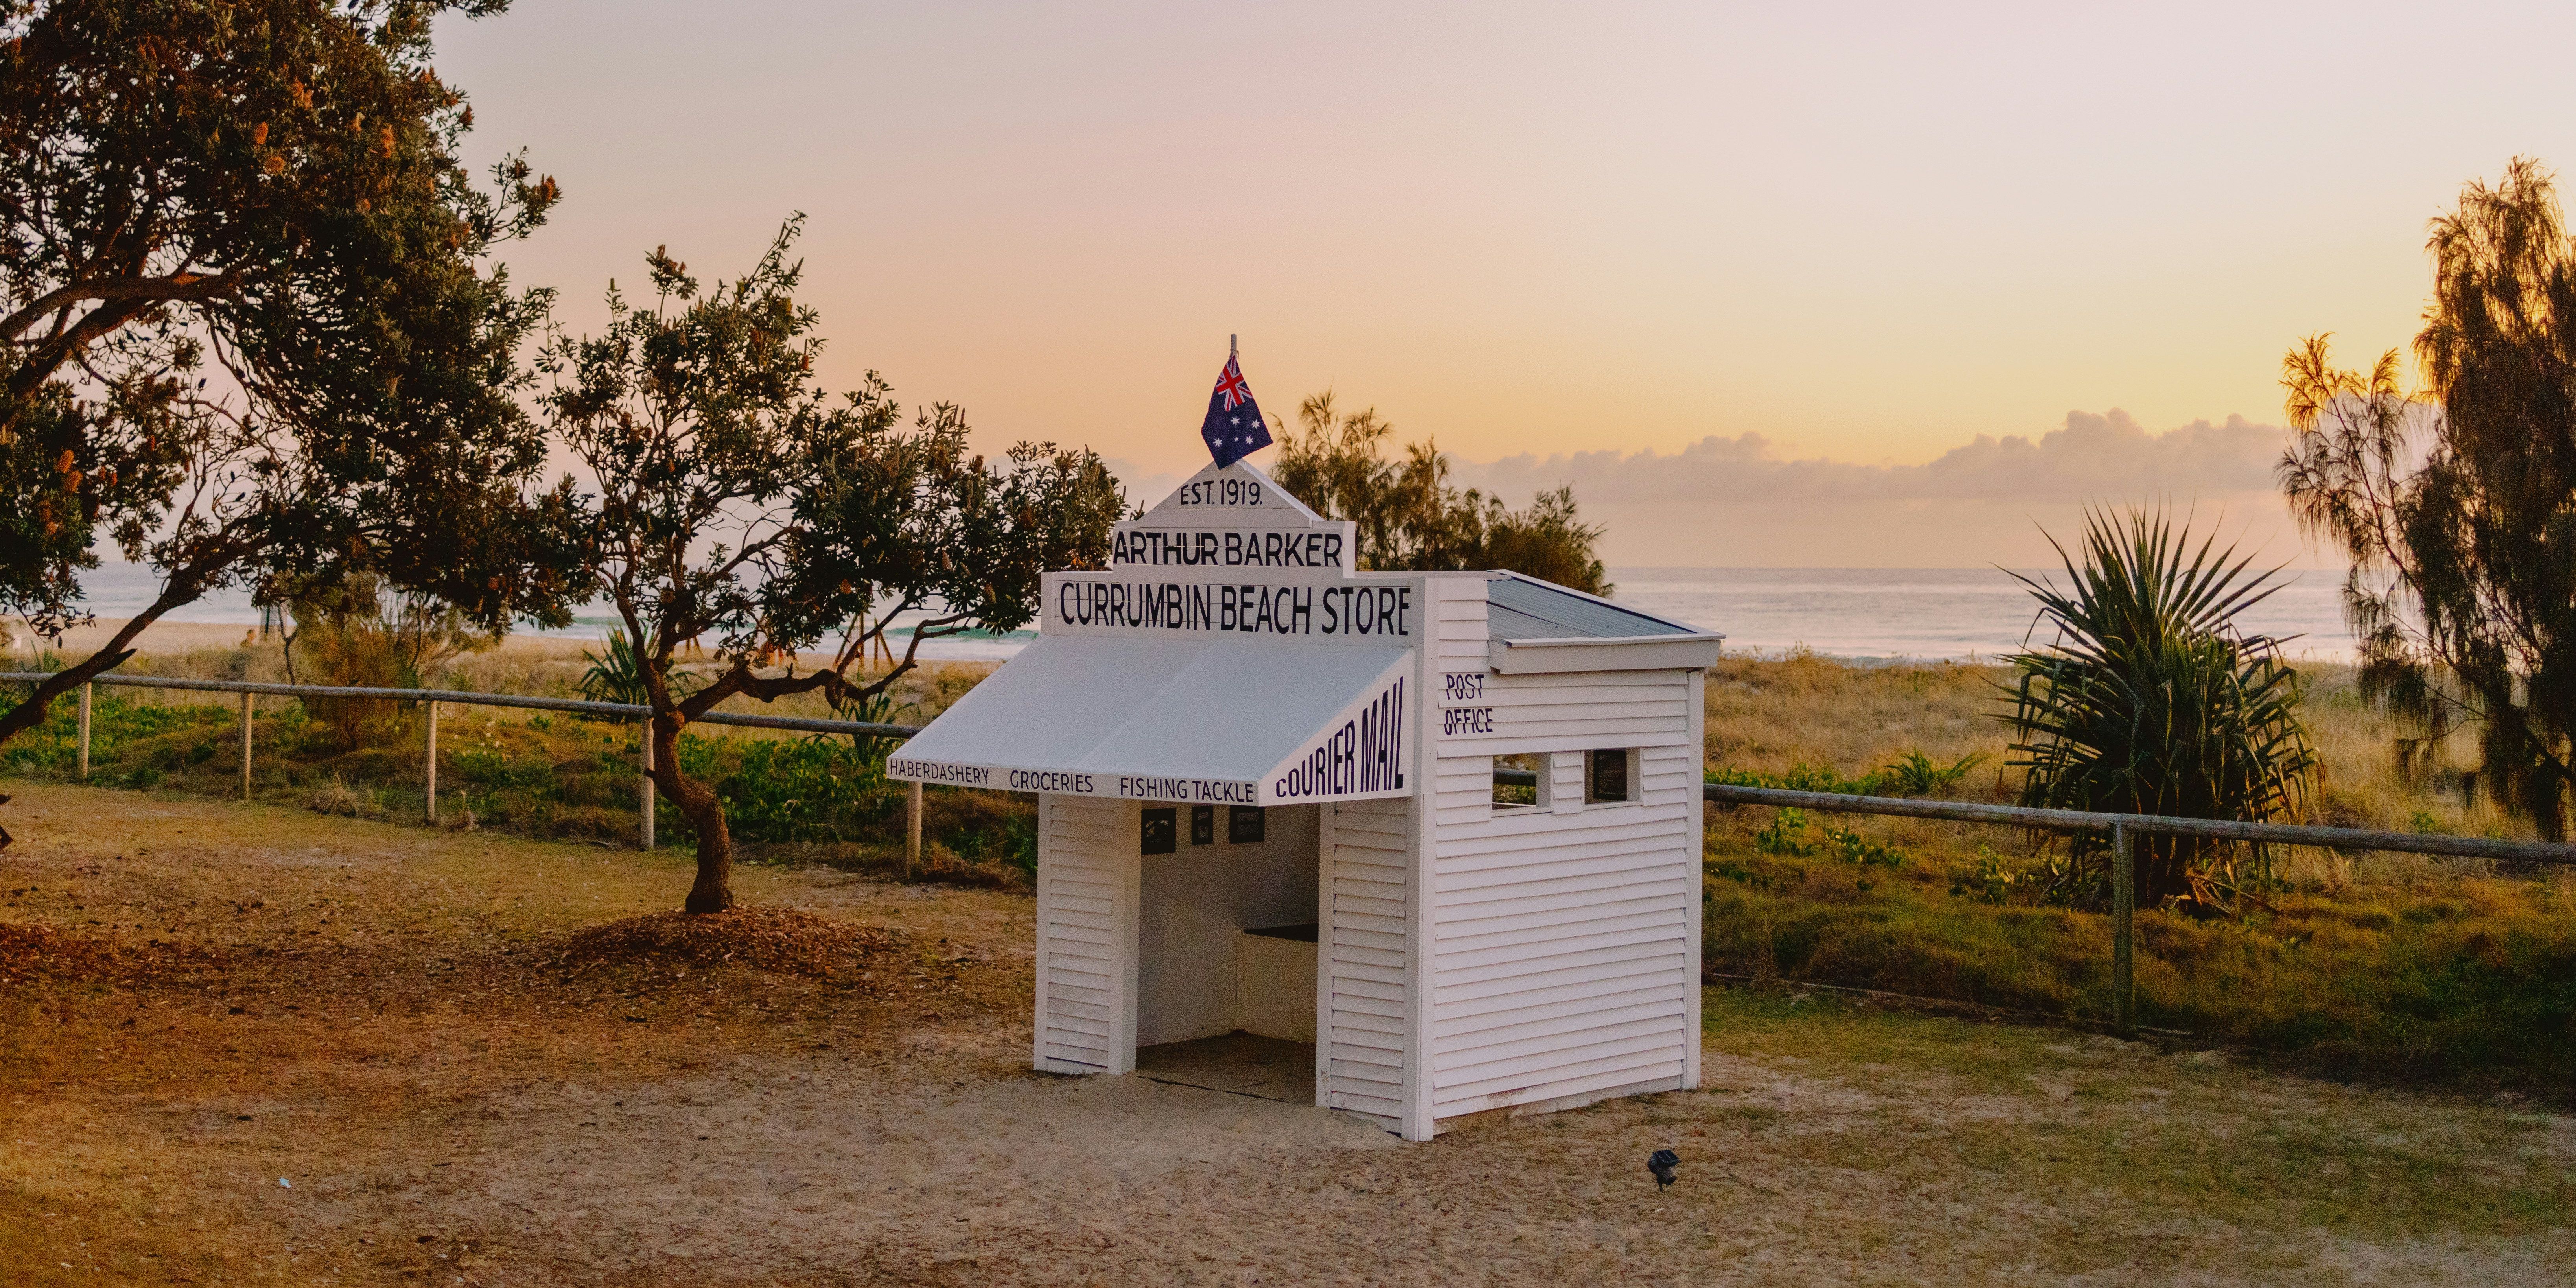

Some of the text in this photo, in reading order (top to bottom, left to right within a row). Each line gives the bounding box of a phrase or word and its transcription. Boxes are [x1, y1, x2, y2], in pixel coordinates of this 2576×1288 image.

[1181, 479, 1262, 505] EST. 1919.
[1113, 531, 1342, 567] ARTHUR BARKER
[1061, 583, 1410, 636] CURRUMBIN BEACH STORE
[1446, 674, 1484, 700] POST
[1276, 676, 1403, 797] COURIER MAIL
[1444, 708, 1492, 735] OFFICE
[890, 759, 1253, 803] HABERDASHERY GROCERIES FISHING TACKLE
